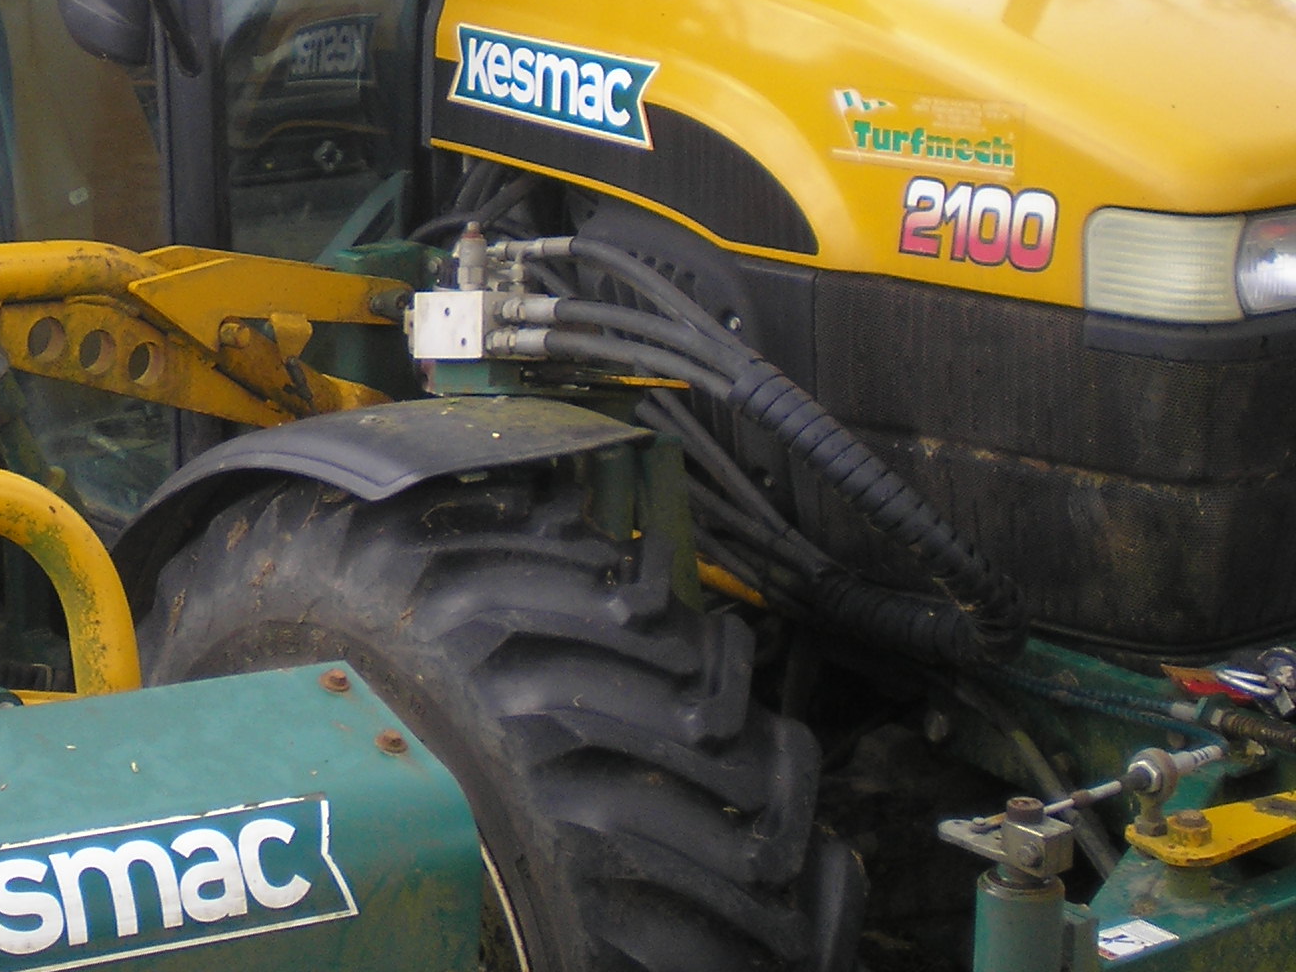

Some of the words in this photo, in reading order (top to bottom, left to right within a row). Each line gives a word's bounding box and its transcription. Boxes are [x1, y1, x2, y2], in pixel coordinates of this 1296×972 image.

[467, 36, 632, 127] kesmac
[853, 120, 1015, 167] Turfmech
[899, 174, 1059, 272] 2100
